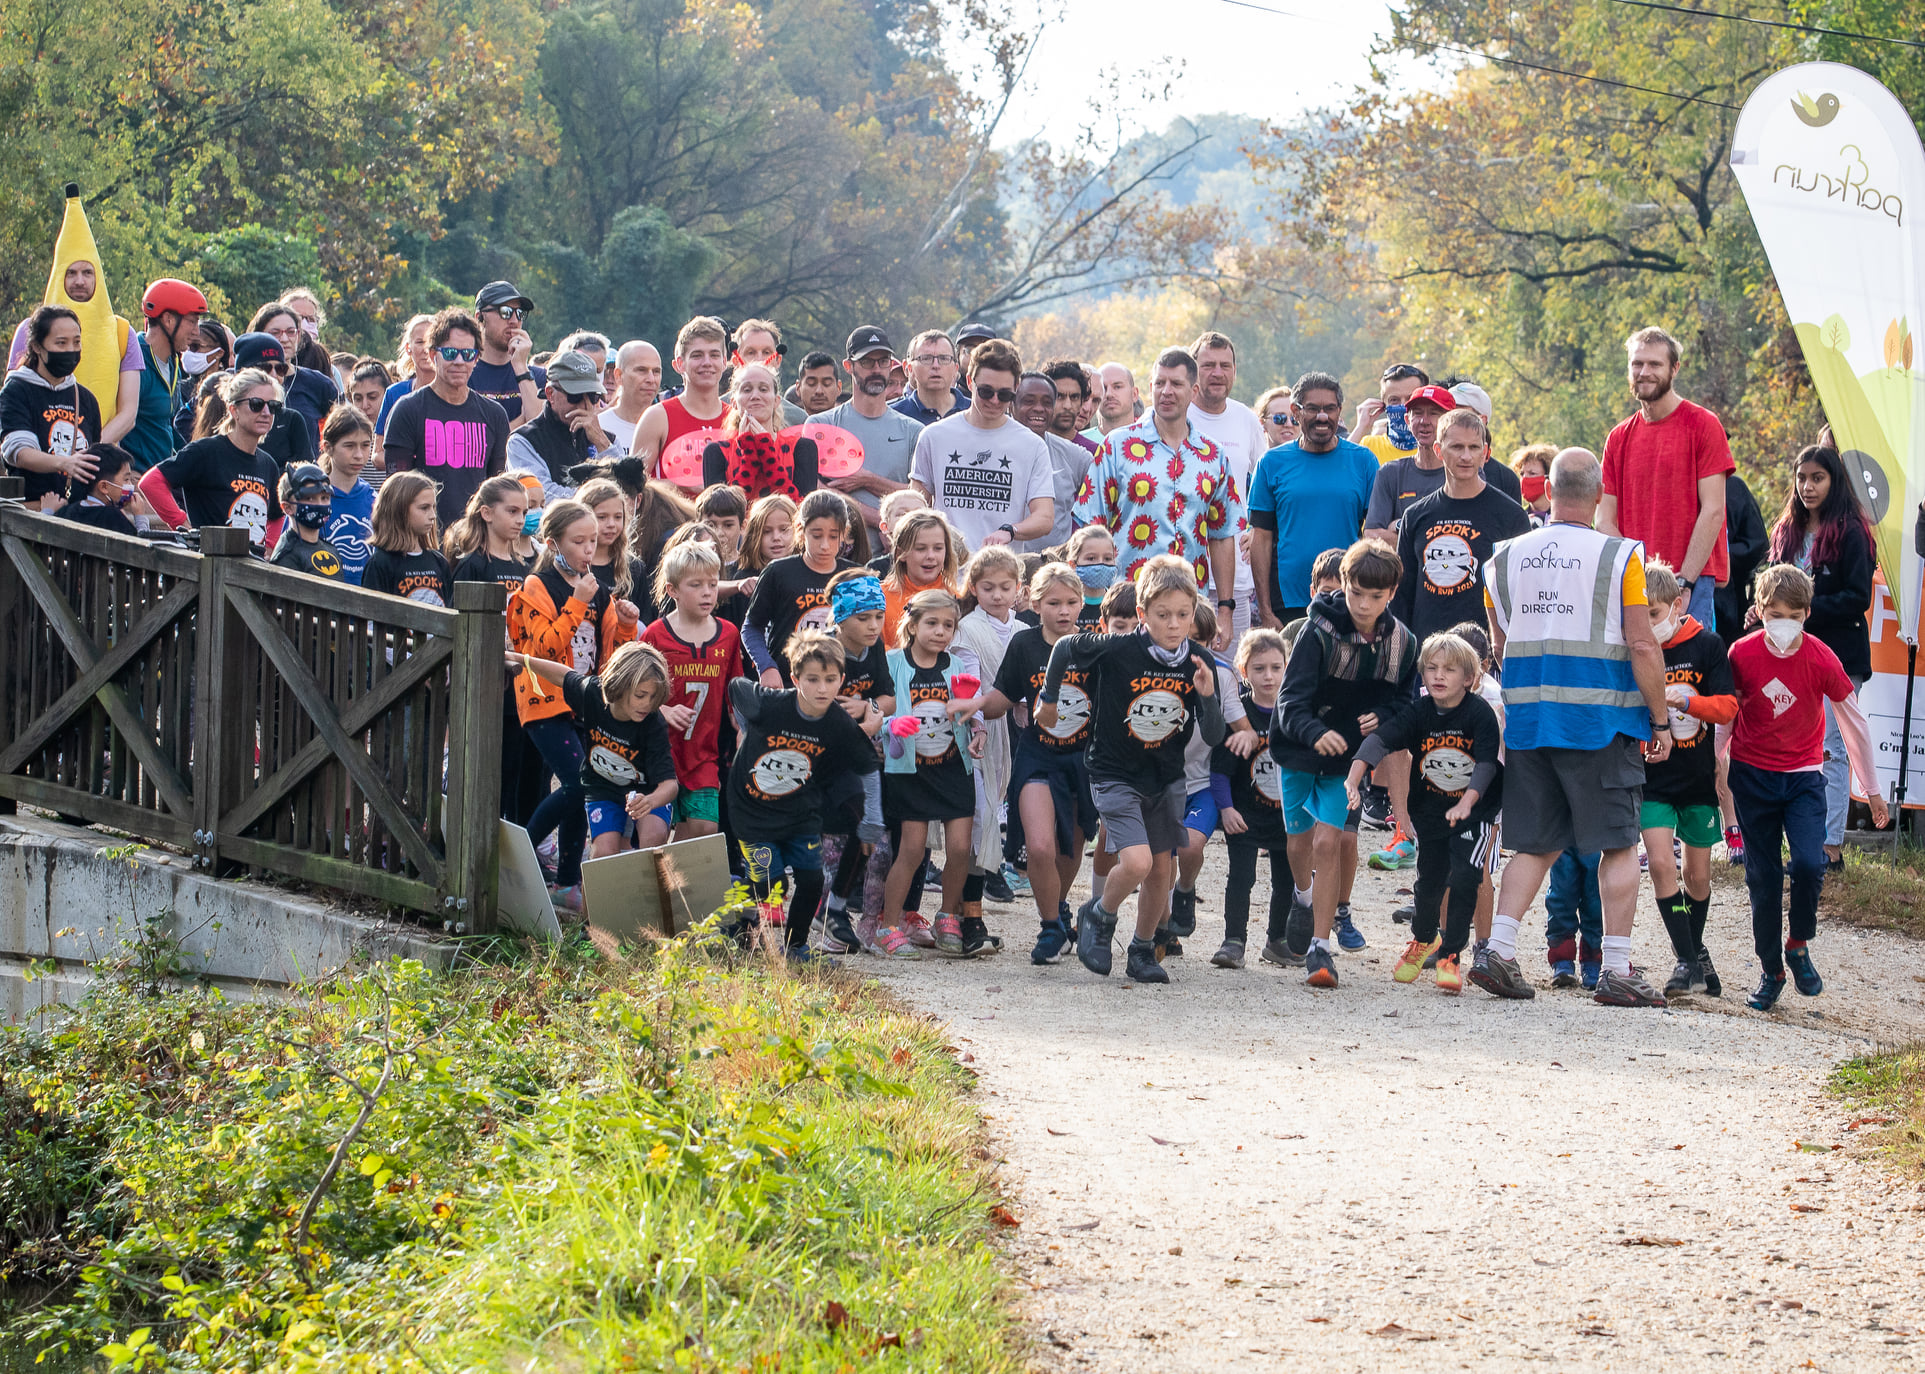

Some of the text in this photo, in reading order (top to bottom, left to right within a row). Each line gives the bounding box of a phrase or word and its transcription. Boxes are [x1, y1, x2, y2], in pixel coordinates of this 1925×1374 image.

[261, 348, 279, 358] KEY
[946, 468, 1012, 485] AMERICAN
[945, 484, 1010, 500] UNIVERSITY
[943, 498, 1011, 513] CLUB XCTF
[1425, 523, 1481, 540] SPOOKY
[1520, 541, 1581, 572] parkrun
[398, 575, 443, 594] SPOOKY
[1423, 580, 1474, 596] FUN RUN 2021
[1538, 590, 1559, 601] RUN
[1521, 603, 1574, 615] DIRECTOR
[674, 663, 720, 677] MARYLAND
[1665, 669, 1704, 684] OOKY
[1030, 671, 1090, 689] SPOKY
[1130, 676, 1194, 695] SPOOKY
[910, 687, 949, 702] POOK
[1774, 694, 1793, 705] KEY
[684, 681, 710, 741] 7
[589, 729, 640, 761] SPOOKY
[766, 735, 826, 757] SPOOKY
[1039, 734, 1056, 745] FUN
[1059, 736, 1077, 747] RUN
[1421, 735, 1474, 752] SPOOKY
